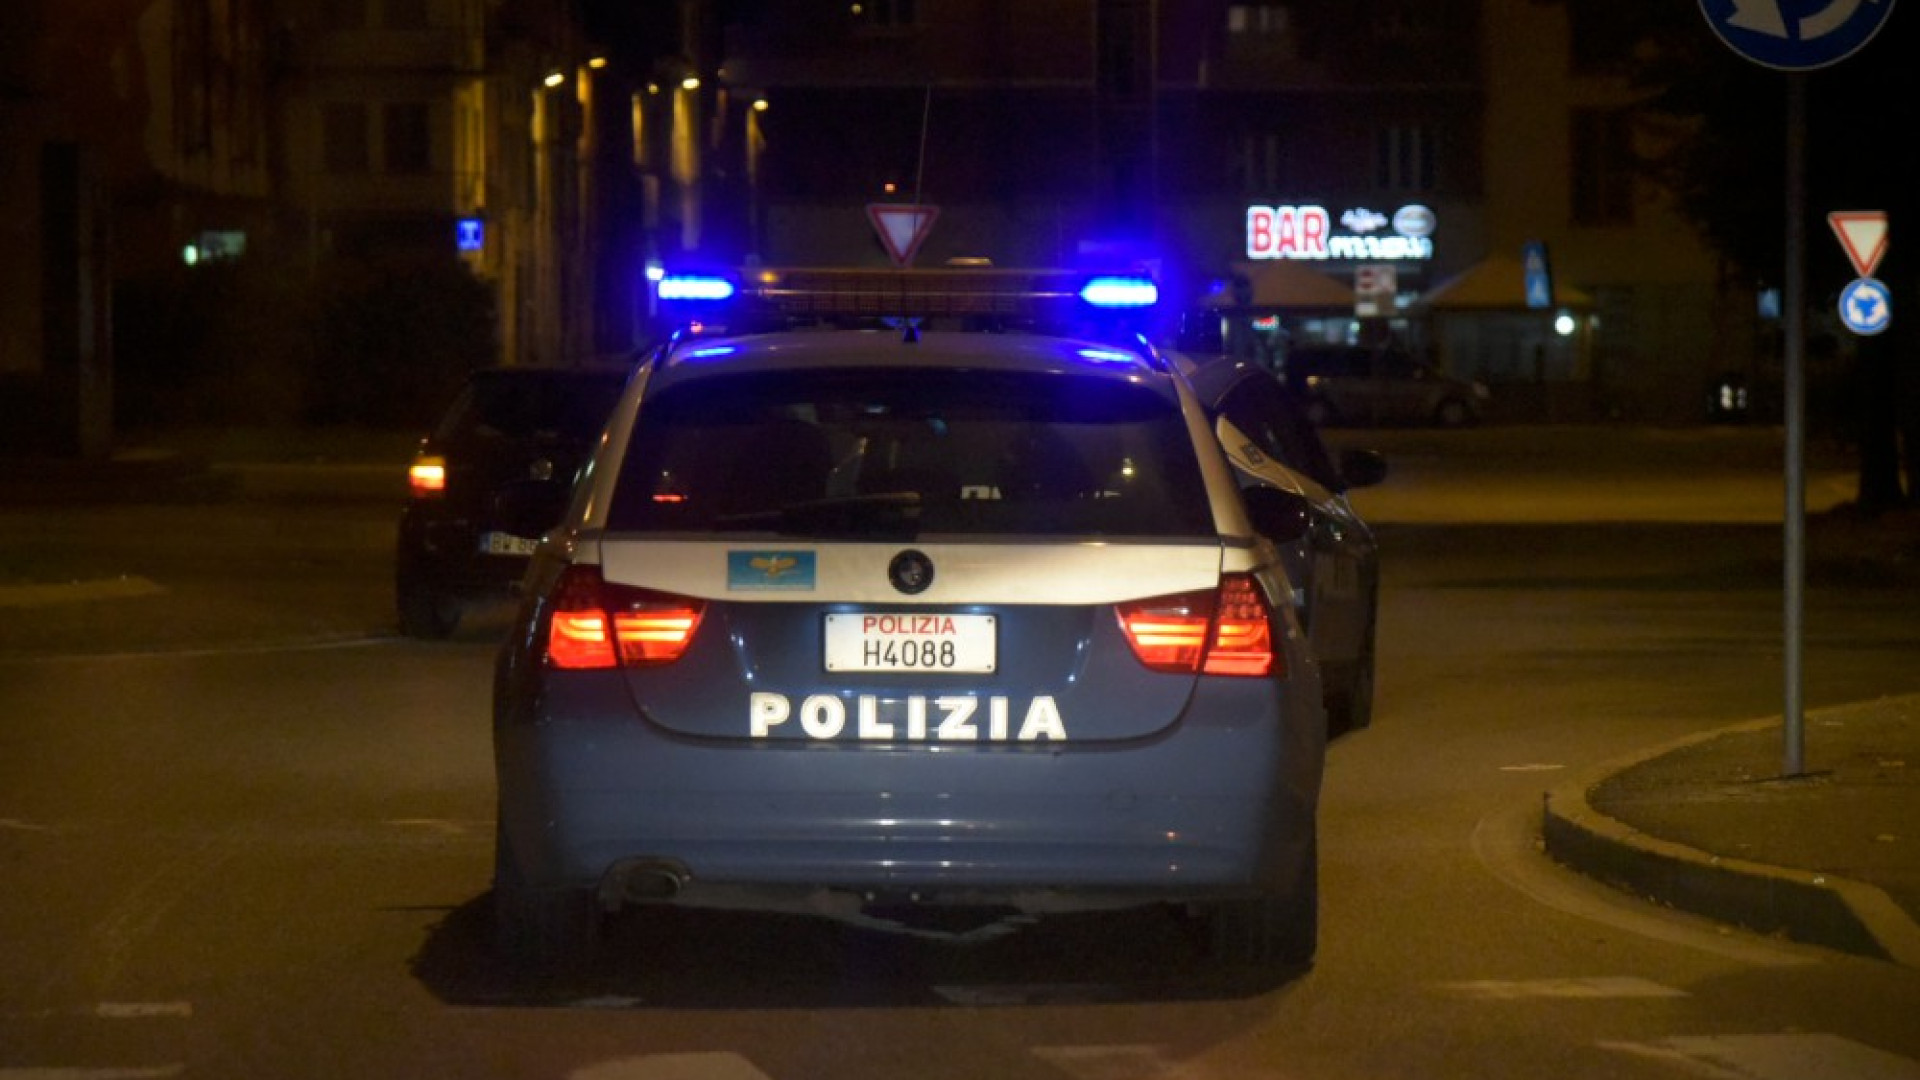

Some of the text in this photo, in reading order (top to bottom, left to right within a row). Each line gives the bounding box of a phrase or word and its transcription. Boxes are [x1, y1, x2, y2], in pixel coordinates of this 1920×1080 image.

[1248, 207, 1328, 257] BAR
[863, 615, 957, 635] POLIZIA
[863, 640, 956, 667] H4088
[750, 692, 1067, 740] POLIZIA
